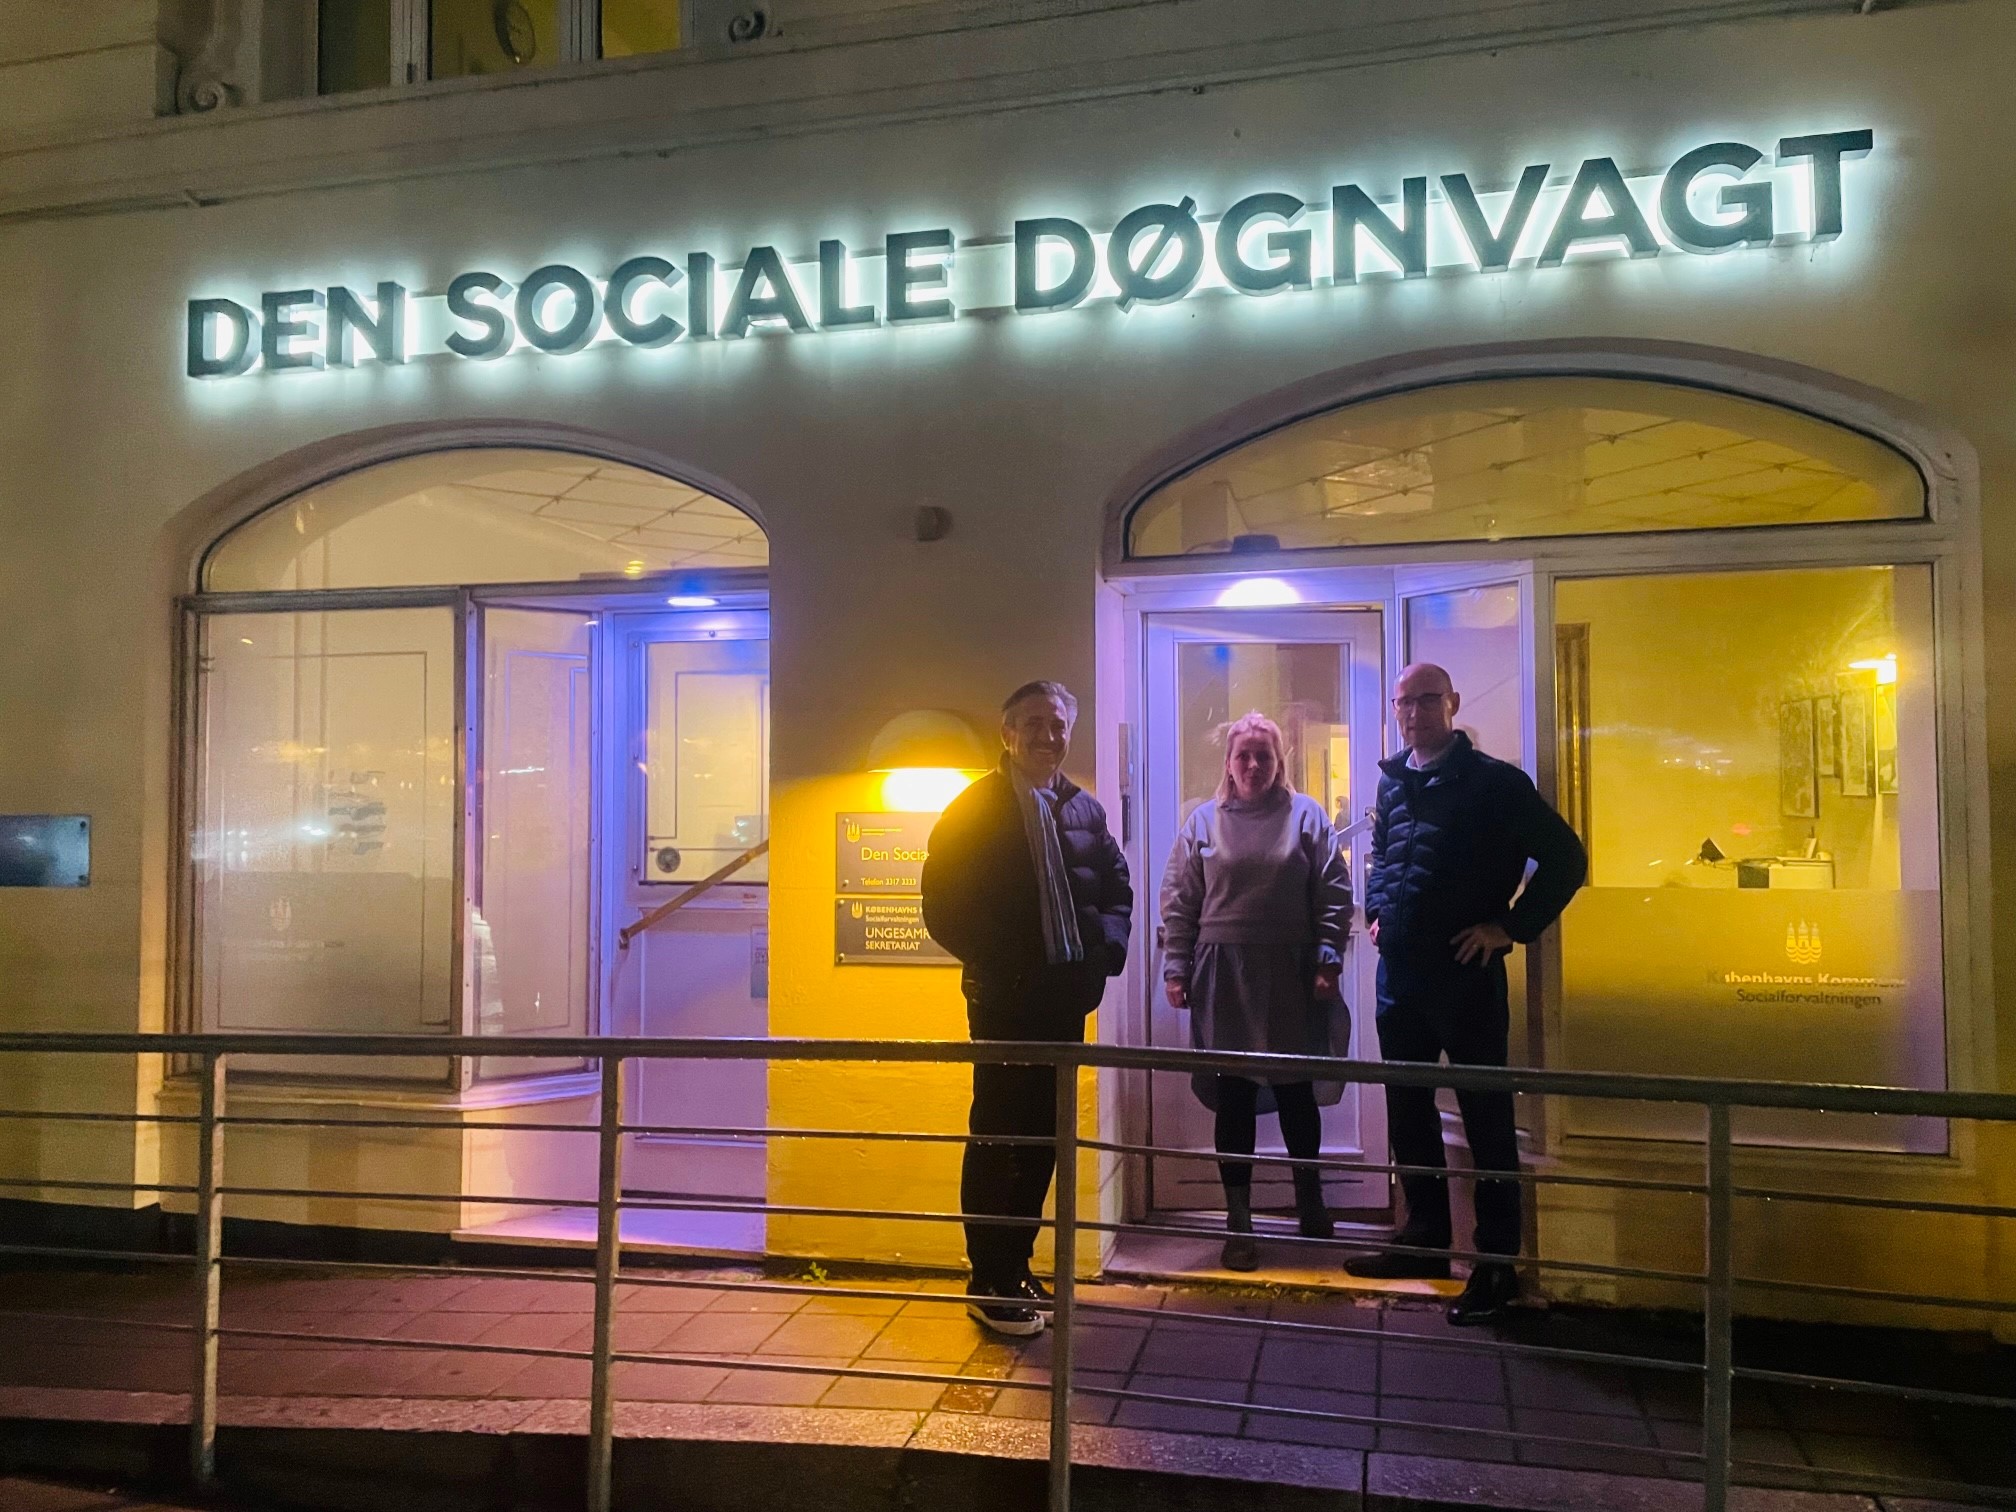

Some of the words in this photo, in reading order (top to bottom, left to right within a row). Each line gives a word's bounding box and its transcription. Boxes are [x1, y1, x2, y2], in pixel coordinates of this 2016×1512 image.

[187, 281, 406, 381] DEN
[445, 228, 956, 362] SOCIALE
[1013, 128, 1873, 315] DØGNVAGT
[861, 847, 889, 861] Den
[893, 847, 930, 861] Socia
[861, 877, 883, 886] Telefon
[865, 906, 918, 914] KØBENHAVNS
[865, 915, 920, 924] Socialforvaltningen
[865, 941, 920, 950] SEKRETARIAT
[1736, 988, 1881, 1008] Socialforvaltningen
